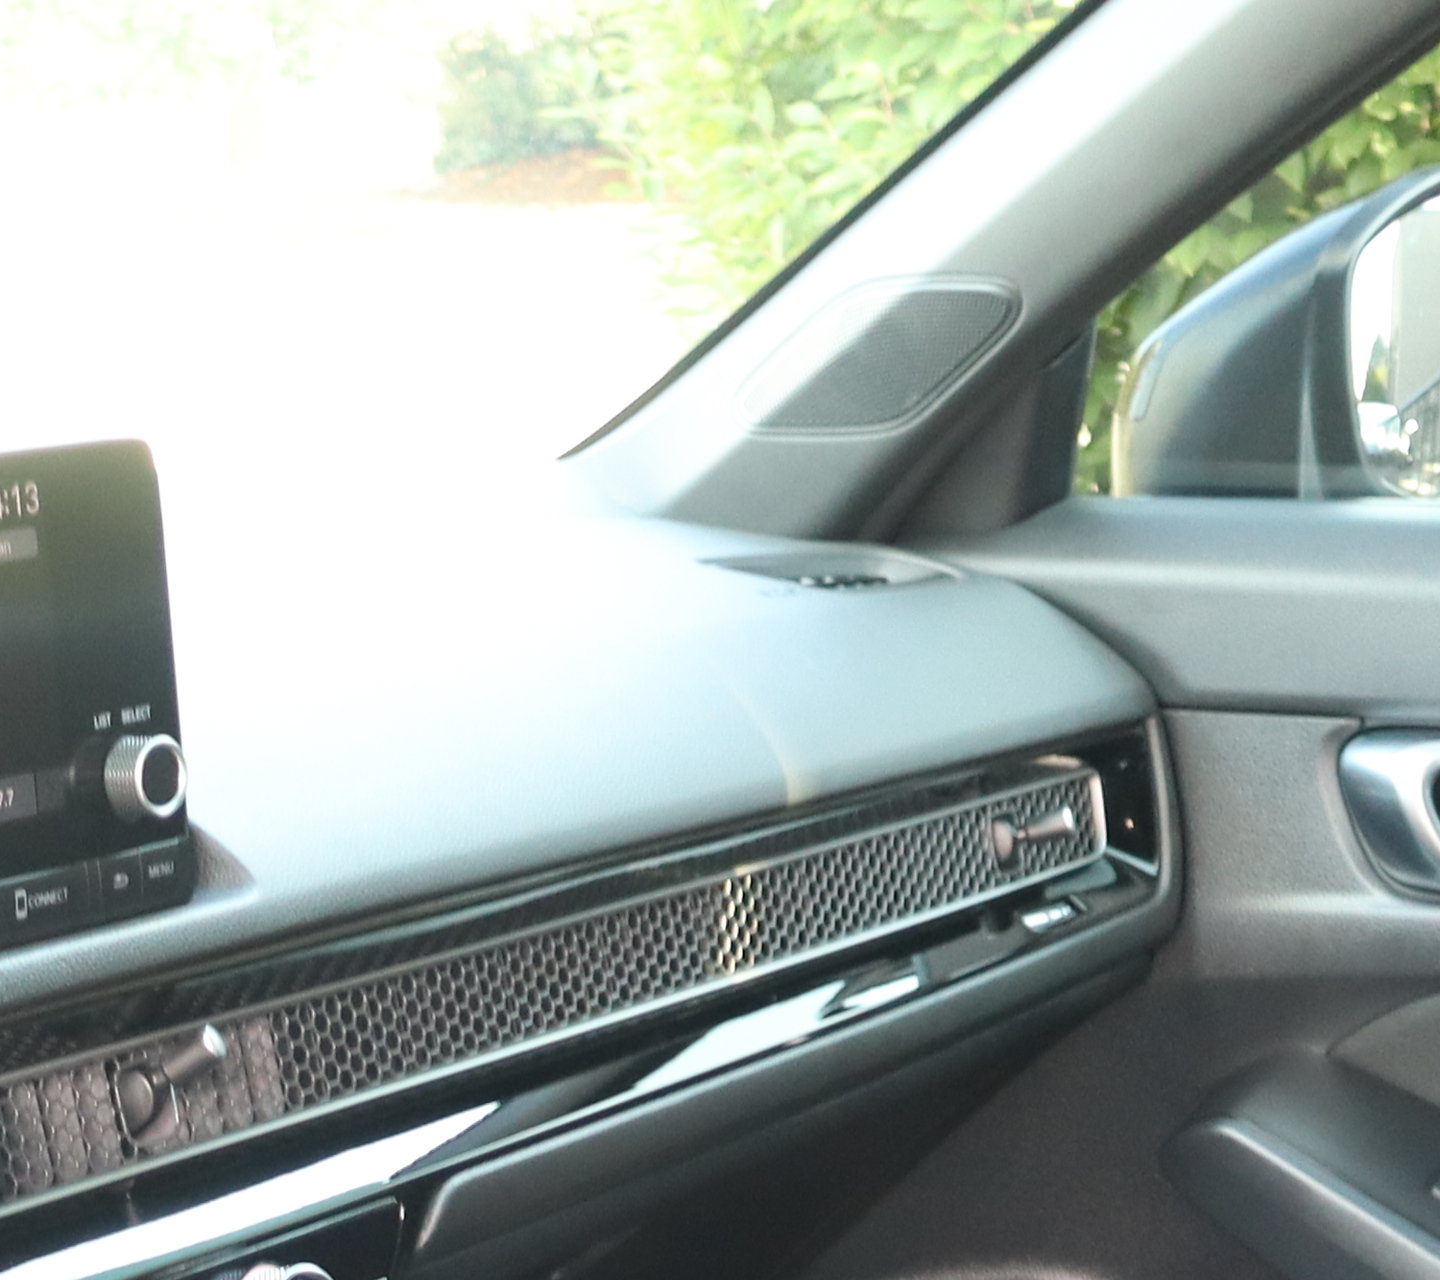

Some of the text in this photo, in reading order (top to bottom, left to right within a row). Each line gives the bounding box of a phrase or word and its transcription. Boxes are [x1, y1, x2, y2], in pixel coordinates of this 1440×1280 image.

[93, 703, 151, 731] LIST SELECT
[147, 860, 175, 880] MENU
[27, 887, 69, 913] CONNECT
